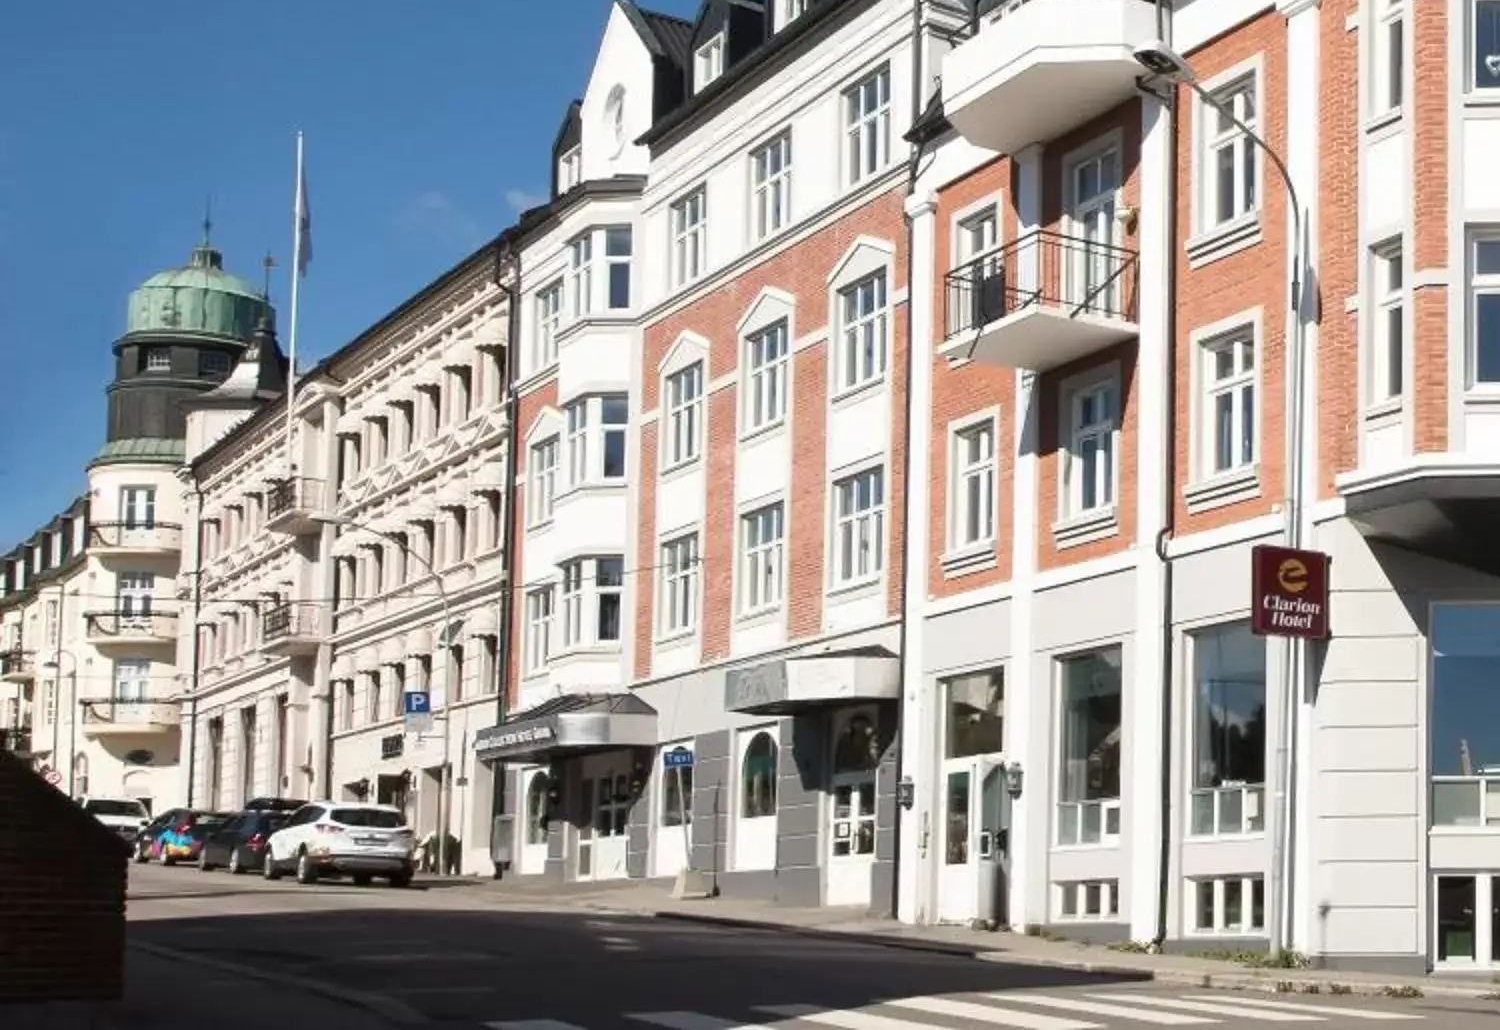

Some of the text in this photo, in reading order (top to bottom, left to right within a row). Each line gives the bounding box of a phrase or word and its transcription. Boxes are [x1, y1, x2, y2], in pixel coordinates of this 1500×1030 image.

[1263, 594, 1320, 615] Clarion
[1271, 611, 1313, 629] Hotel
[411, 694, 425, 711] P
